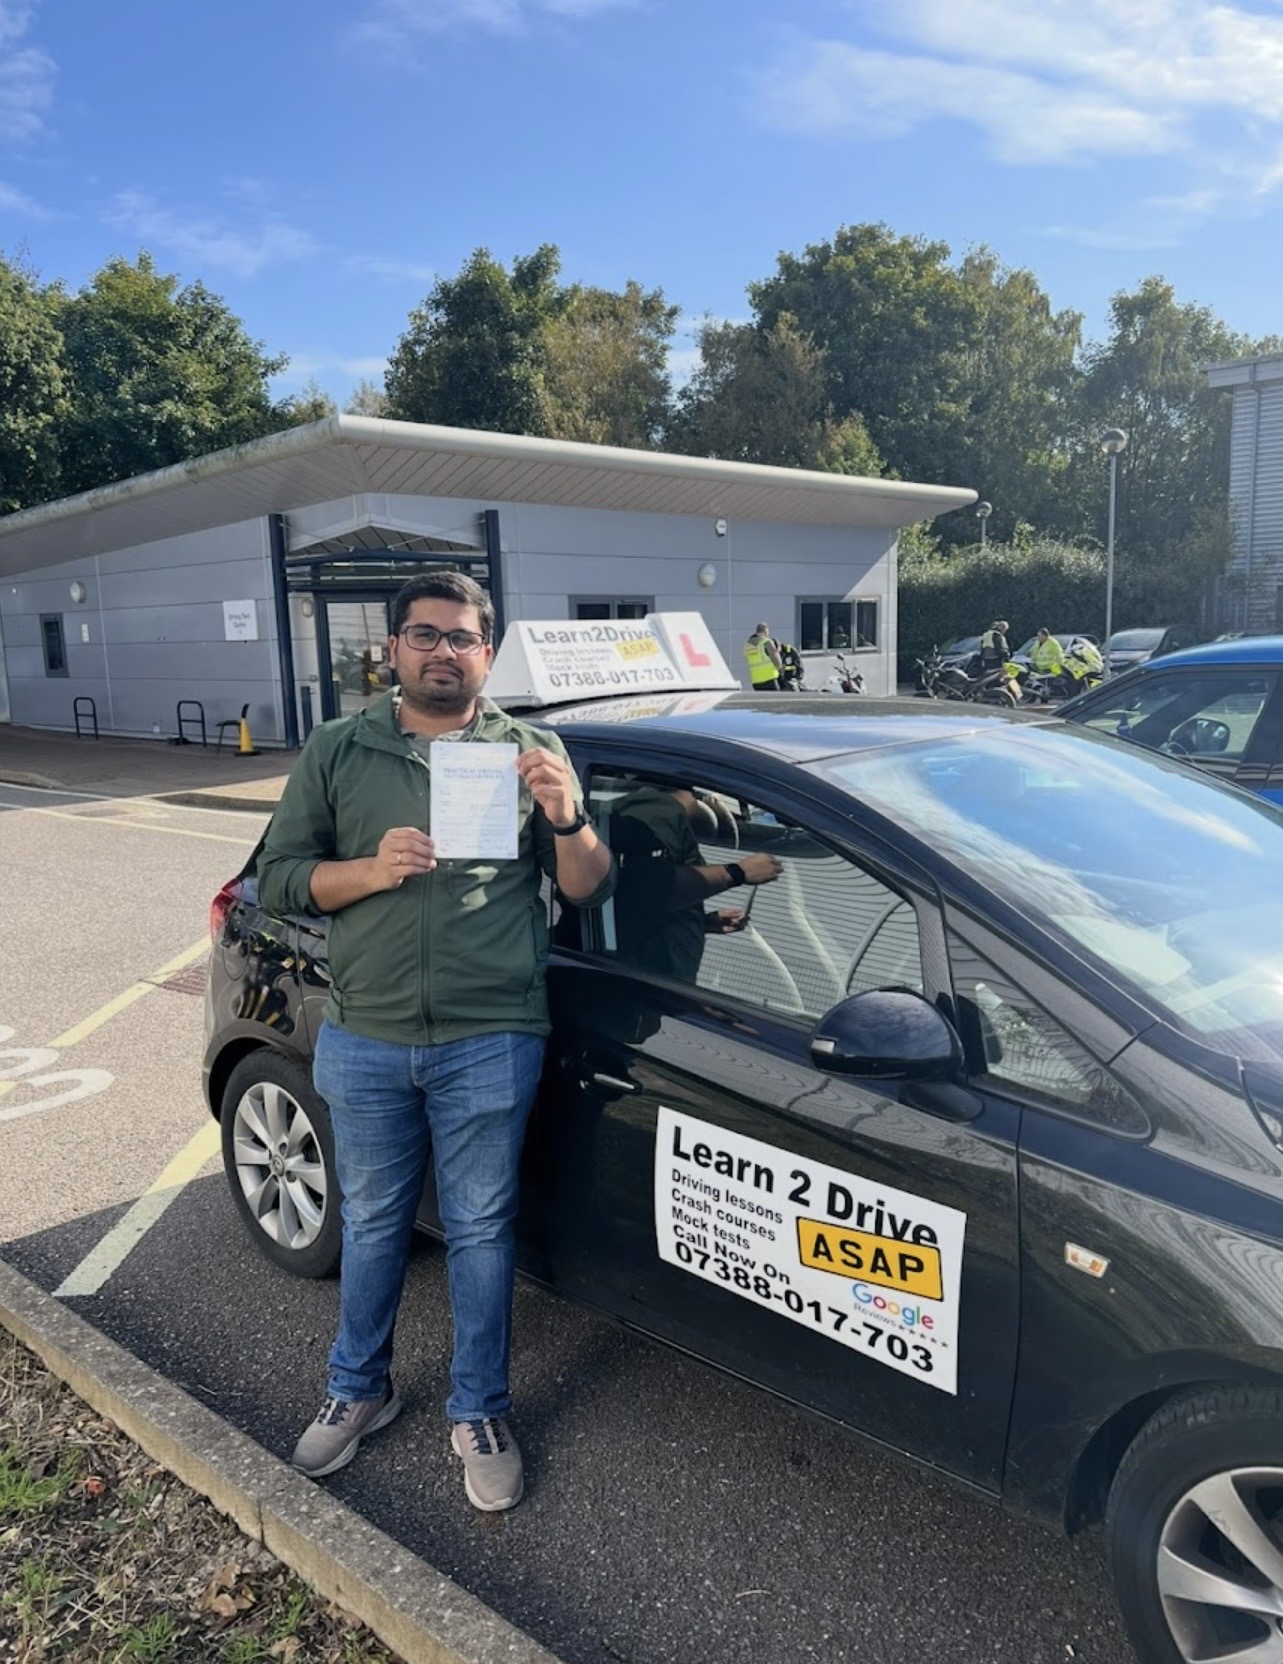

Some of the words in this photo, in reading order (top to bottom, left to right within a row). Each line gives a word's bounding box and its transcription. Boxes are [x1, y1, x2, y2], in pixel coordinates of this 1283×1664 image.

[623, 642, 654, 657] ASAP
[678, 633, 711, 666] L
[549, 667, 675, 688] 07388-017-703
[672, 1125, 774, 1194] Learn
[788, 1169, 812, 1207] 2
[827, 1182, 938, 1246] Drive
[672, 1169, 721, 1202] Driving
[725, 1189, 783, 1224] lessons
[672, 1188, 712, 1216] Crash
[716, 1207, 776, 1241] courses
[672, 1206, 709, 1233] Mock
[713, 1224, 750, 1250] tests
[673, 1225, 707, 1250] Call
[714, 1241, 757, 1269] Now
[764, 1264, 791, 1285] On
[812, 1233, 925, 1282] ASAP
[675, 1242, 934, 1373] 07388-017-703
[852, 1283, 934, 1330] Google
[853, 1303, 897, 1327] Reviews
